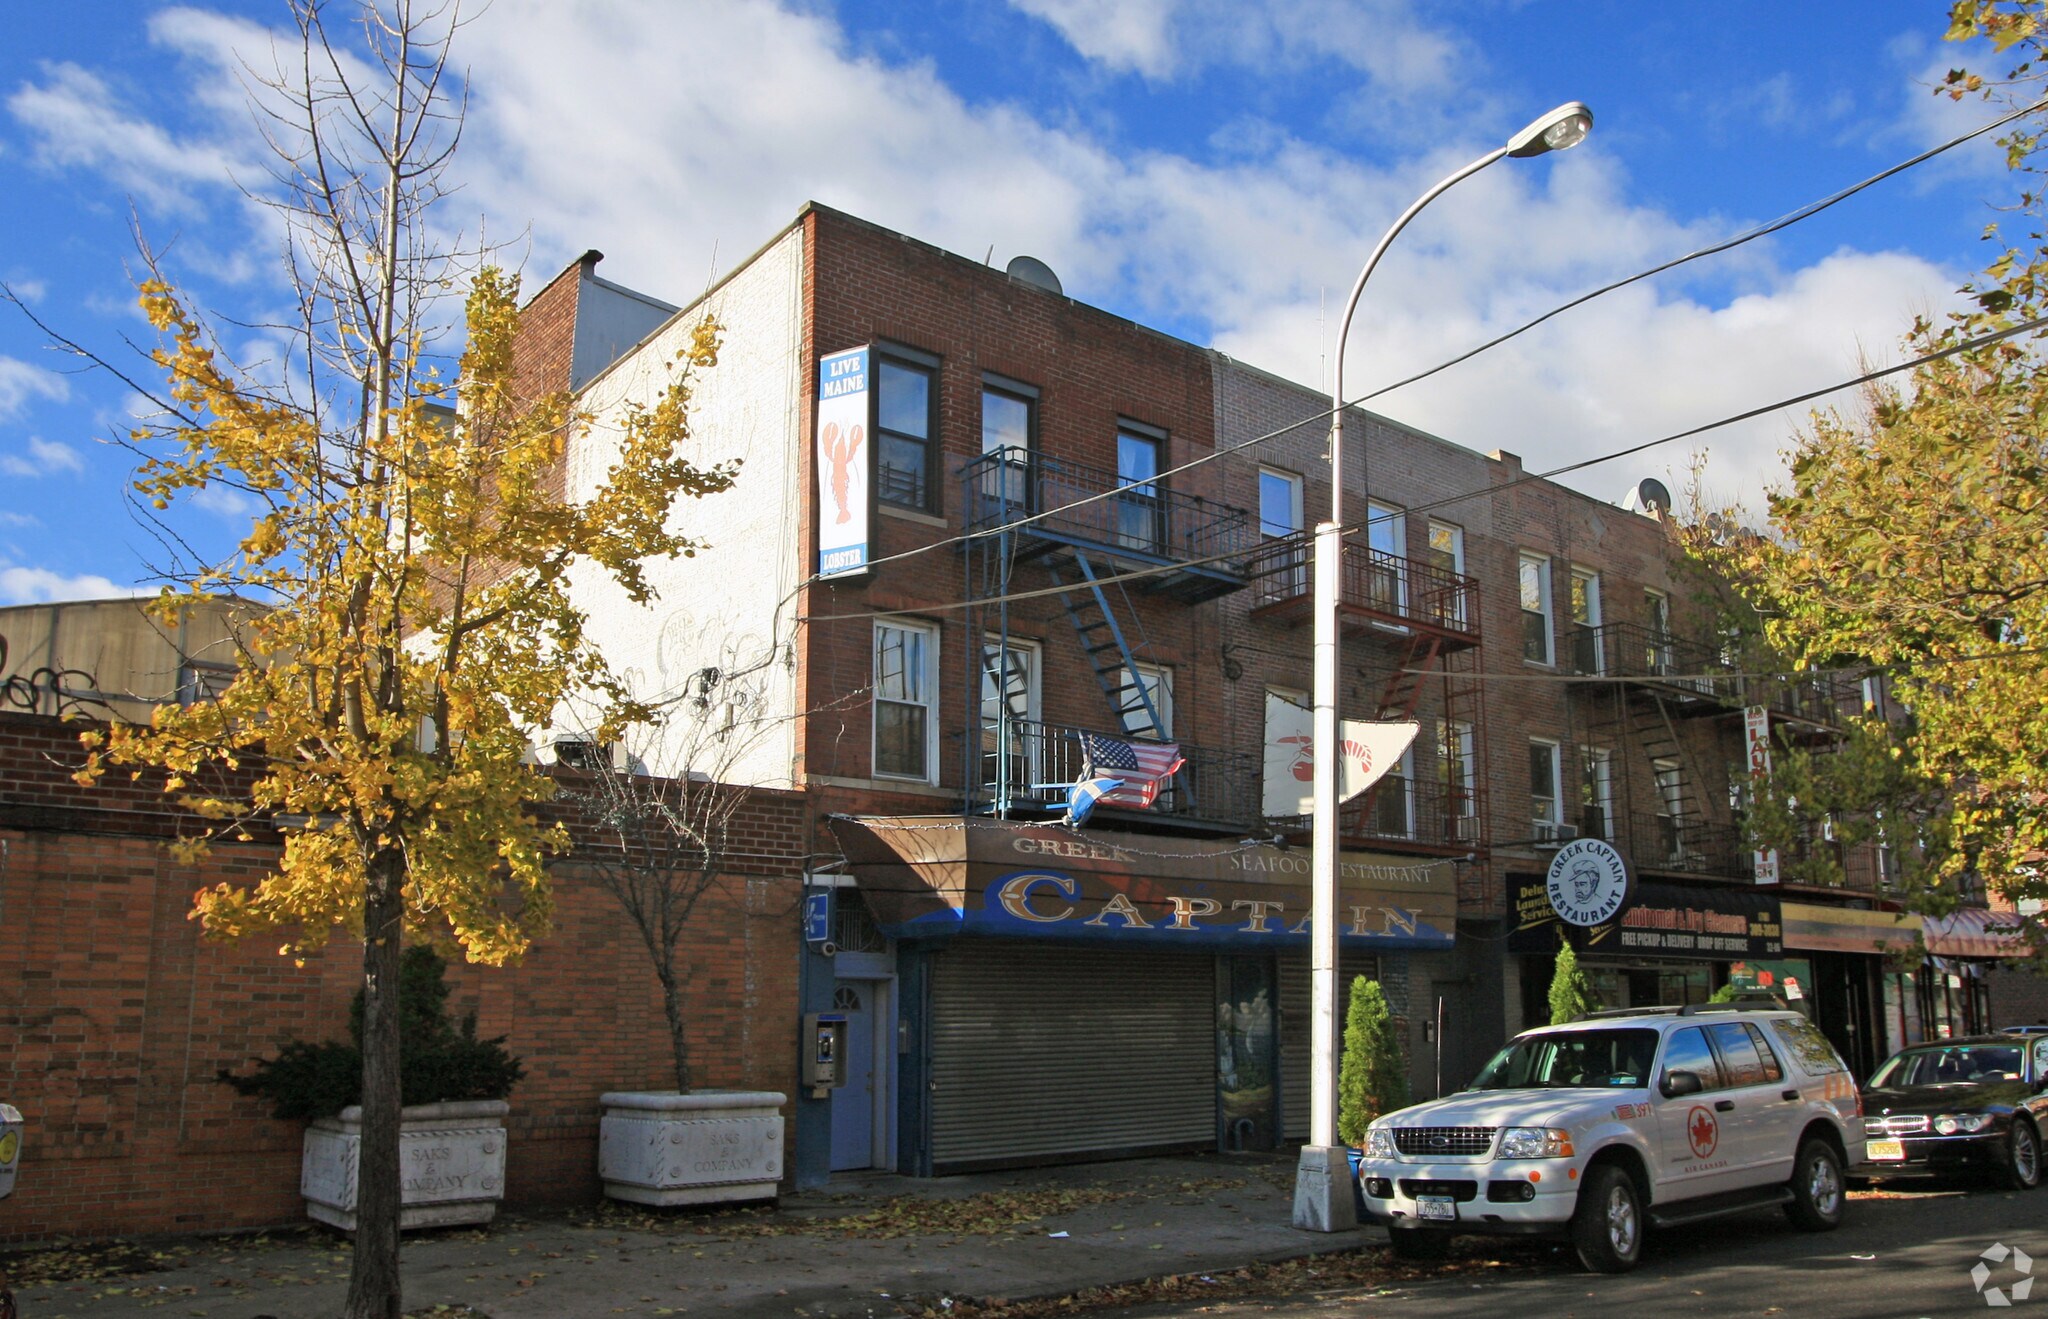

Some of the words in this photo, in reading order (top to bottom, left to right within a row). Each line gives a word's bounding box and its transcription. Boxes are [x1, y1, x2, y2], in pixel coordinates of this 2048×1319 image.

[830, 356, 861, 377] LIVE
[823, 374, 864, 398] MAINE
[823, 548, 861, 570] LOBSTER
[1013, 838, 1136, 862] GREEK
[1230, 854, 1313, 875] SEAFOO
[1340, 862, 1431, 883] ESTAURANT
[1550, 843, 1583, 878] GREEK
[1586, 842, 1624, 883] CAPTAIN
[1550, 883, 1621, 923] RESTAURANT
[1621, 932, 1636, 946] FREE
[1637, 932, 1660, 947] PICKUP
[1667, 934, 1694, 949] DELIVERY
[1697, 936, 1713, 950] DROP
[1725, 938, 1749, 952] SERVICE
[412, 1147, 450, 1161] SAKS
[1699, 1160, 1728, 1171] CANADA
[401, 1175, 471, 1192] OMPANY
